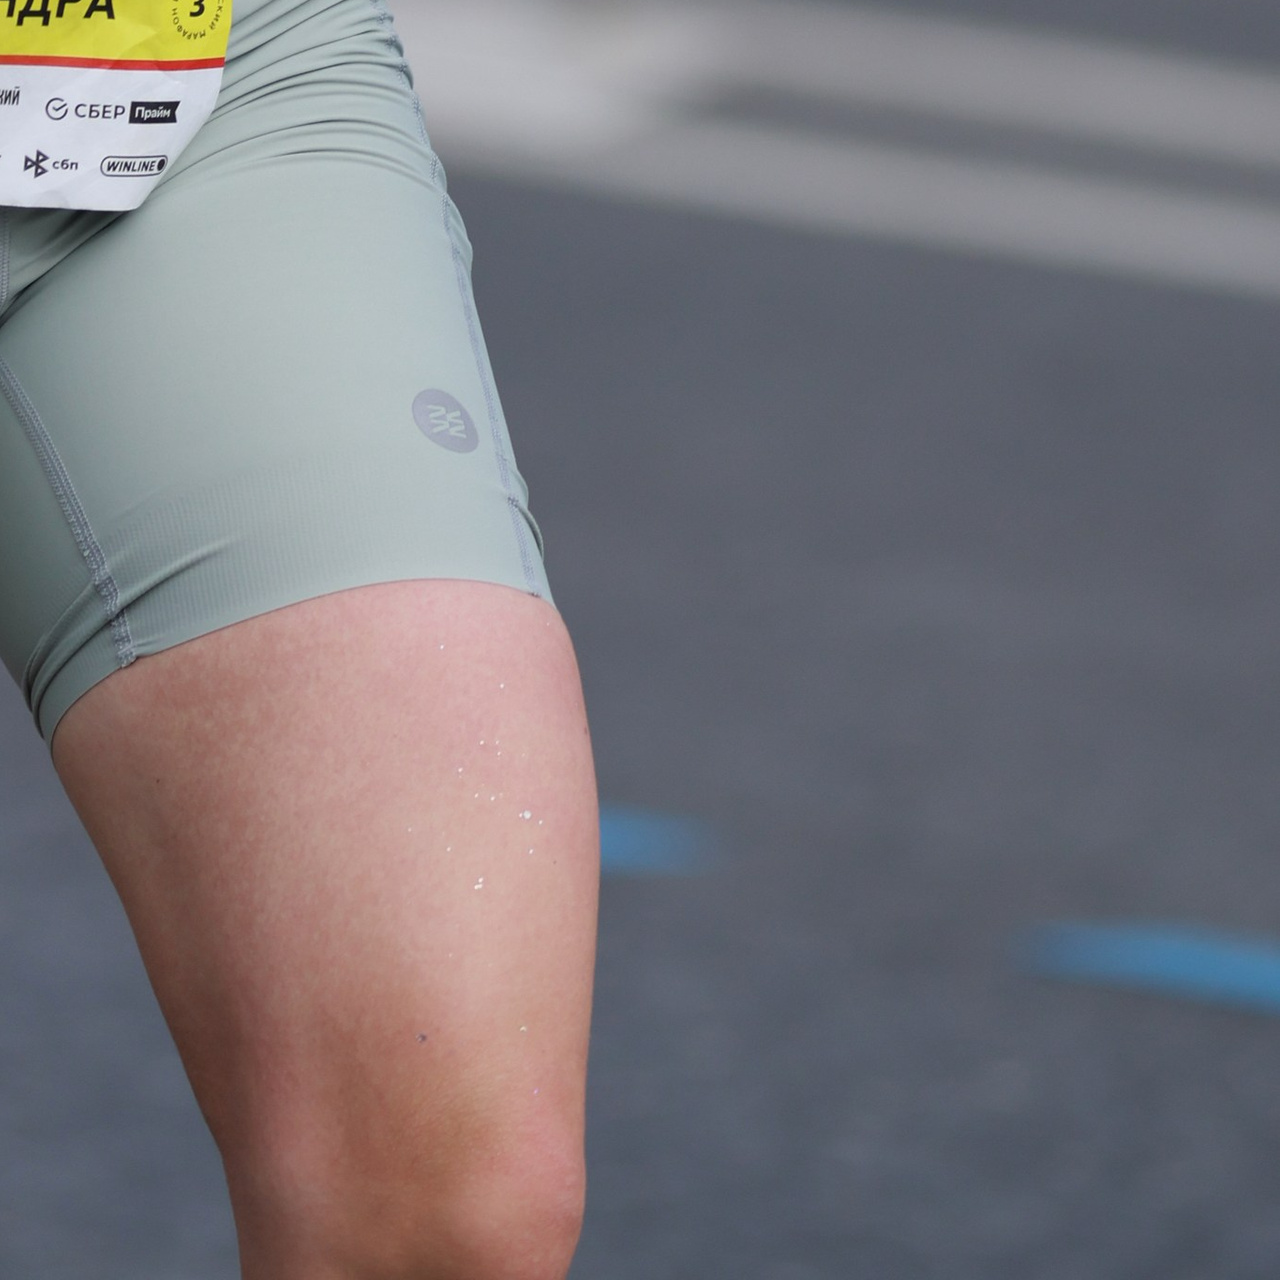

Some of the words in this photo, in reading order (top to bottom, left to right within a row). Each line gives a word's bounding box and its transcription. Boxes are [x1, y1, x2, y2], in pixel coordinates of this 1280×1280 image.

[74, 103, 126, 119] СБЕР
[134, 106, 171, 120] Прайм
[52, 158, 78, 170] сбп
[106, 160, 156, 172] WINLINE
